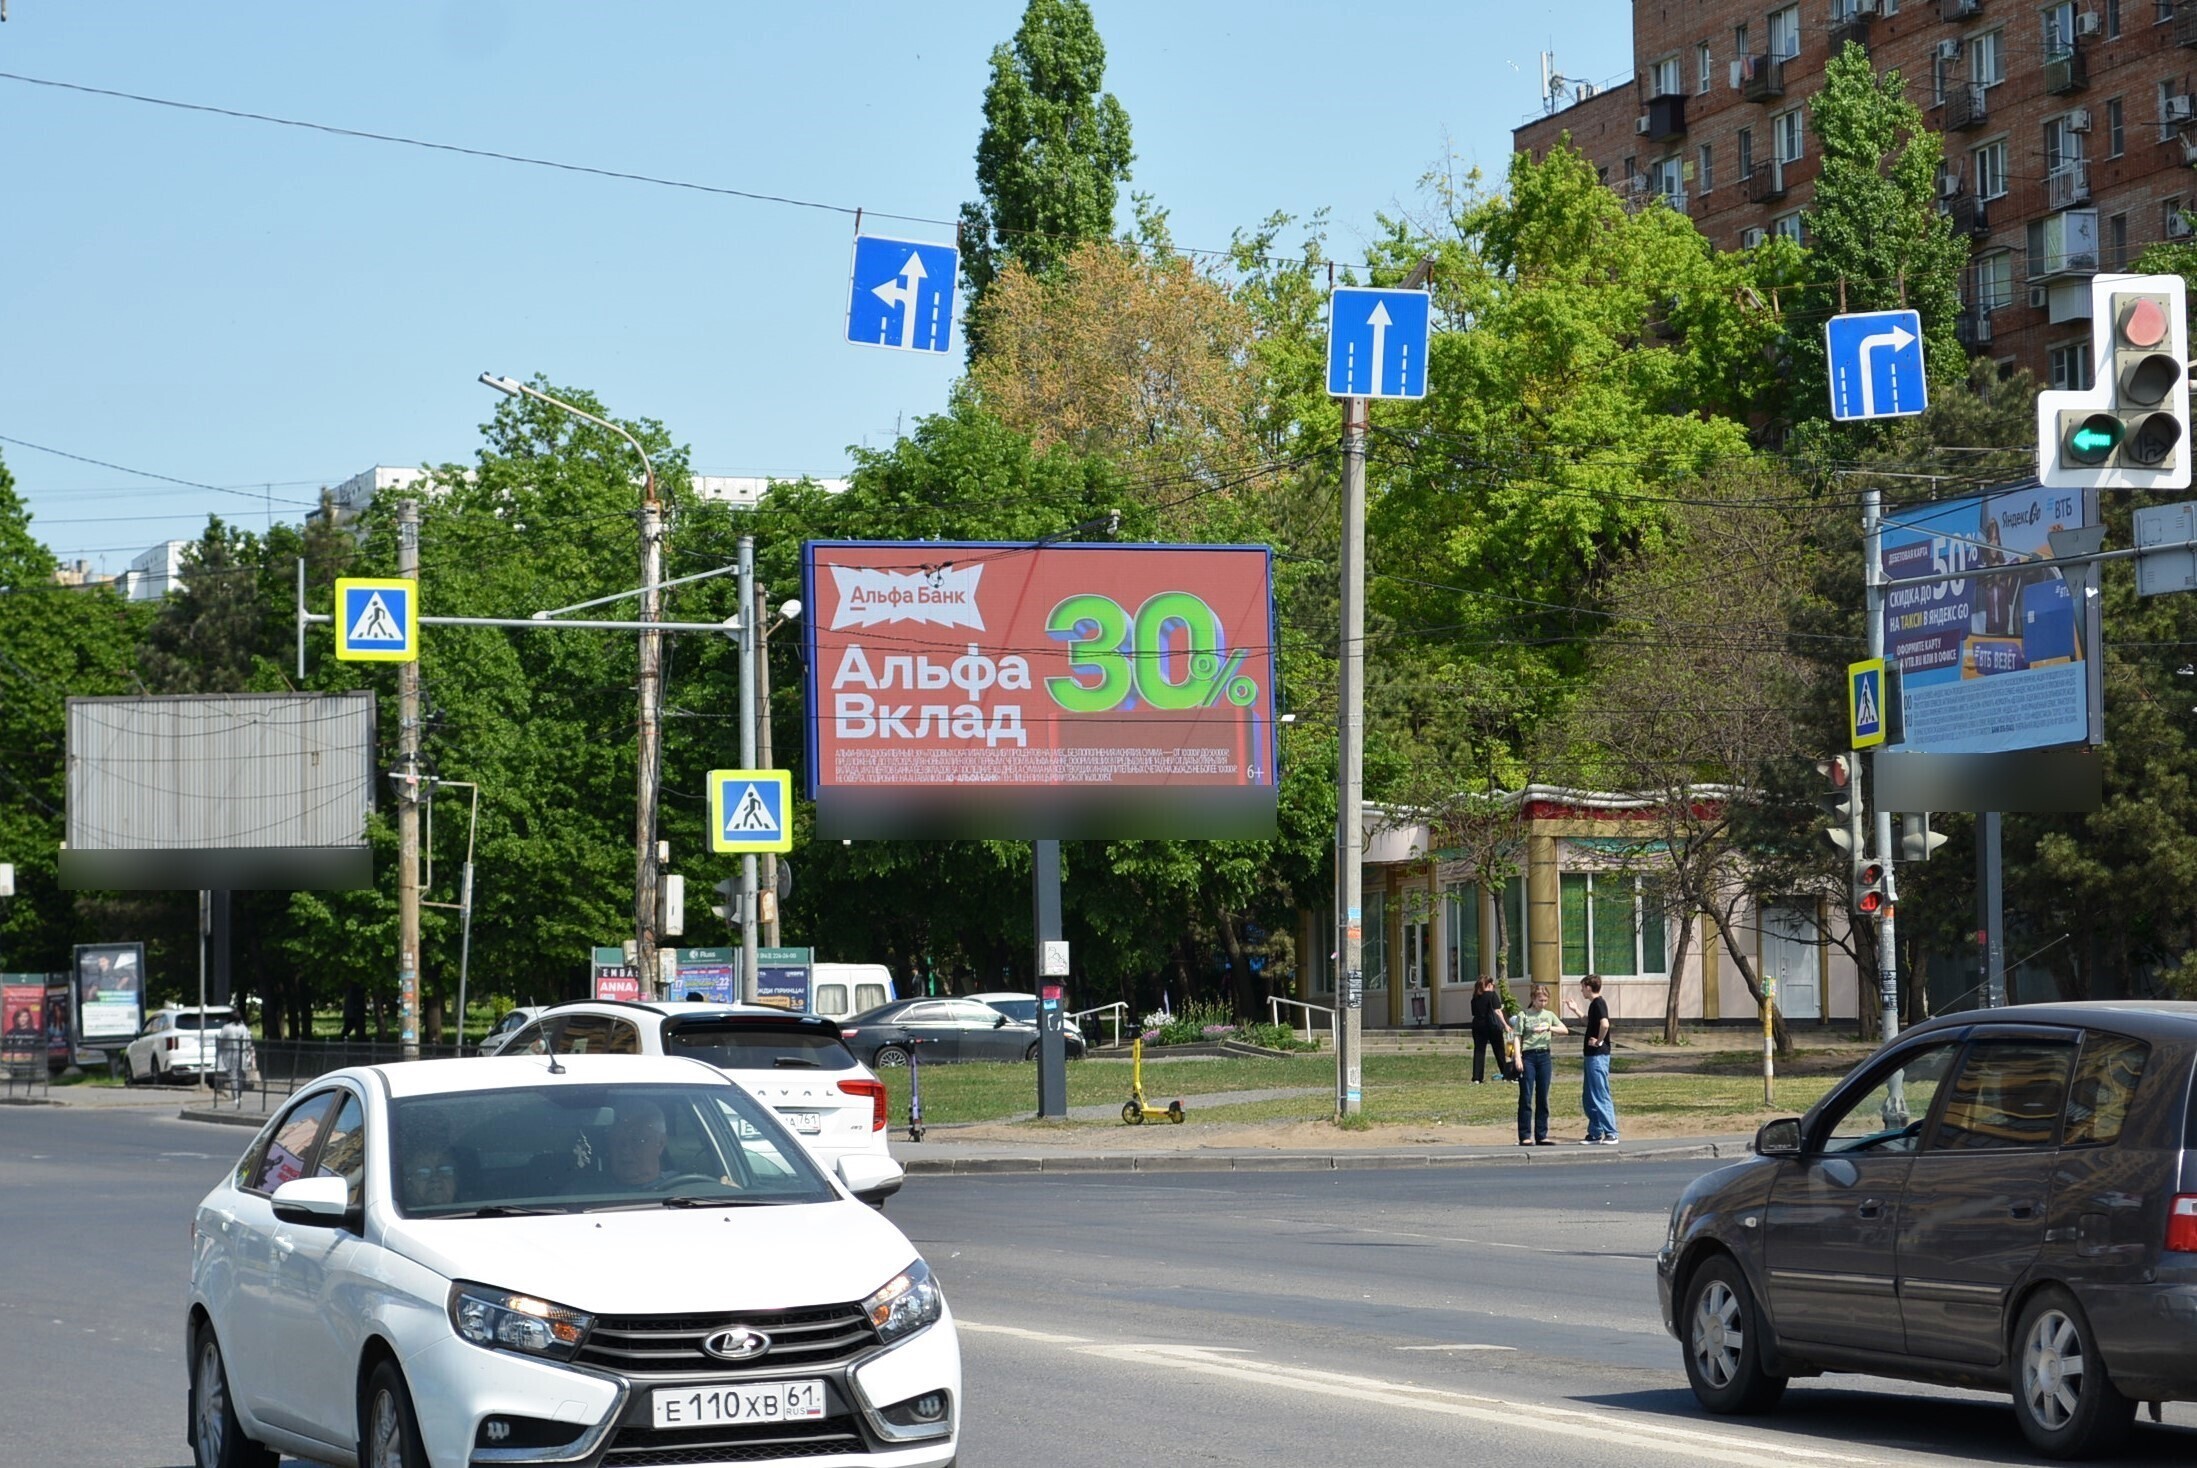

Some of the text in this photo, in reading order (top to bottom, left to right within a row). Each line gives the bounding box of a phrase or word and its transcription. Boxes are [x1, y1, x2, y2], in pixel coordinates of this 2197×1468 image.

[2002, 508, 2029, 528] Яндекс
[2055, 497, 2073, 519] ВТБ
[850, 585, 965, 608] Альфа Банк
[1889, 585, 1932, 608] СКИДКА ДО
[1889, 617, 1900, 632] НА
[1900, 612, 1923, 630] ТАКСИ
[1929, 605, 1957, 626] ЯНДЕКС
[1958, 603, 1969, 619] GO
[1044, 590, 1258, 713] 30%
[1925, 637, 1942, 651] КАРТУ
[1979, 647, 2017, 669] ВТБ ВЕЗЁТ
[832, 643, 1031, 700] Альфа
[836, 693, 1027, 747] Вклад
[1246, 765, 1264, 779] 6+
[600, 981, 634, 992] ANNA
[757, 1089, 834, 1097] AVAL
[799, 1114, 817, 1125] 761
[787, 1385, 814, 1407] 61
[786, 1408, 805, 1416] RUS
